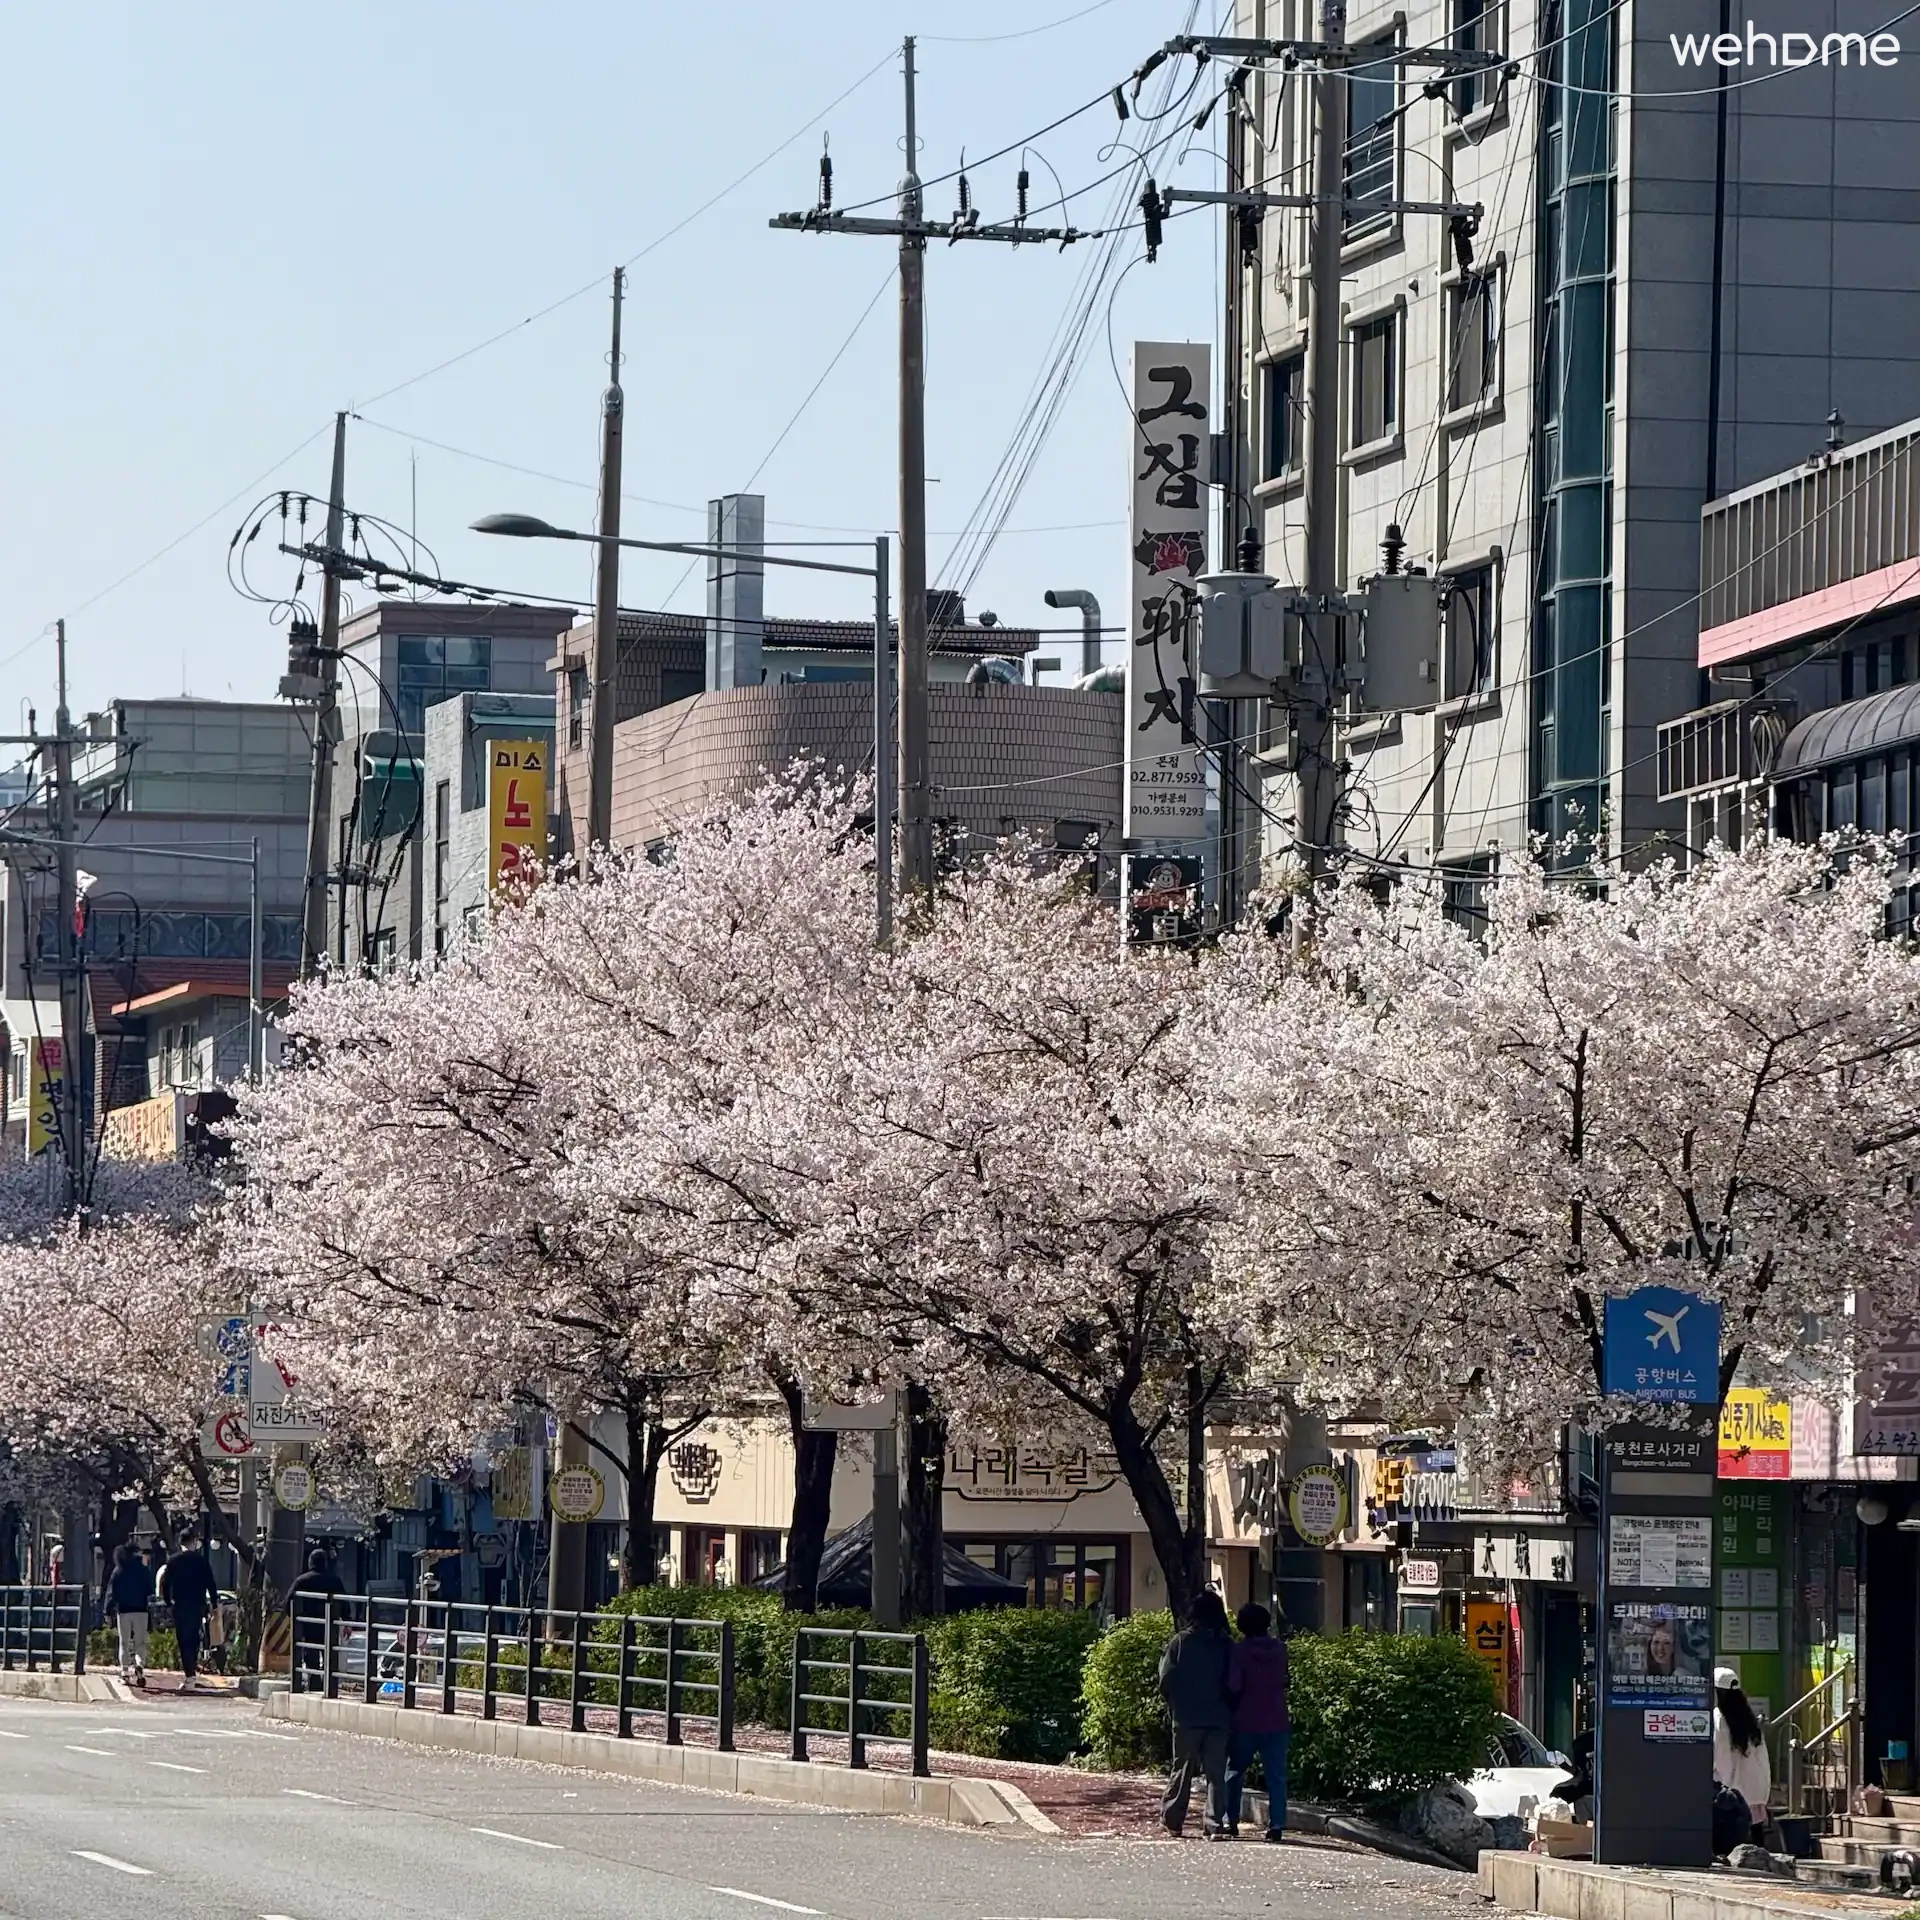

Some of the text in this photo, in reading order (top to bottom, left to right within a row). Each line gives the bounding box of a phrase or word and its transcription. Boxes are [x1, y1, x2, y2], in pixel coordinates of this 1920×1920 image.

[1138, 364, 1208, 509] 그집
[1156, 756, 1179, 768] 본점
[1131, 771, 1205, 783] 02.877.9592
[1148, 792, 1187, 804] 가맹문의
[1131, 806, 1204, 817] 010.9531.9293
[1635, 1368, 1697, 1384] 공항버스
[1635, 1389, 1697, 1399] AIRPORT BUS
[1722, 1402, 1785, 1441] 인중개사
[1613, 1442, 1701, 1457] 봉천로사거리
[952, 1447, 1123, 1485] 나래족발
[1666, 1460, 1692, 1468] Junction
[1403, 1472, 1457, 1507] 873-0012
[1723, 1495, 1772, 1511] 아파트
[1647, 1714, 1676, 1732] 금연
